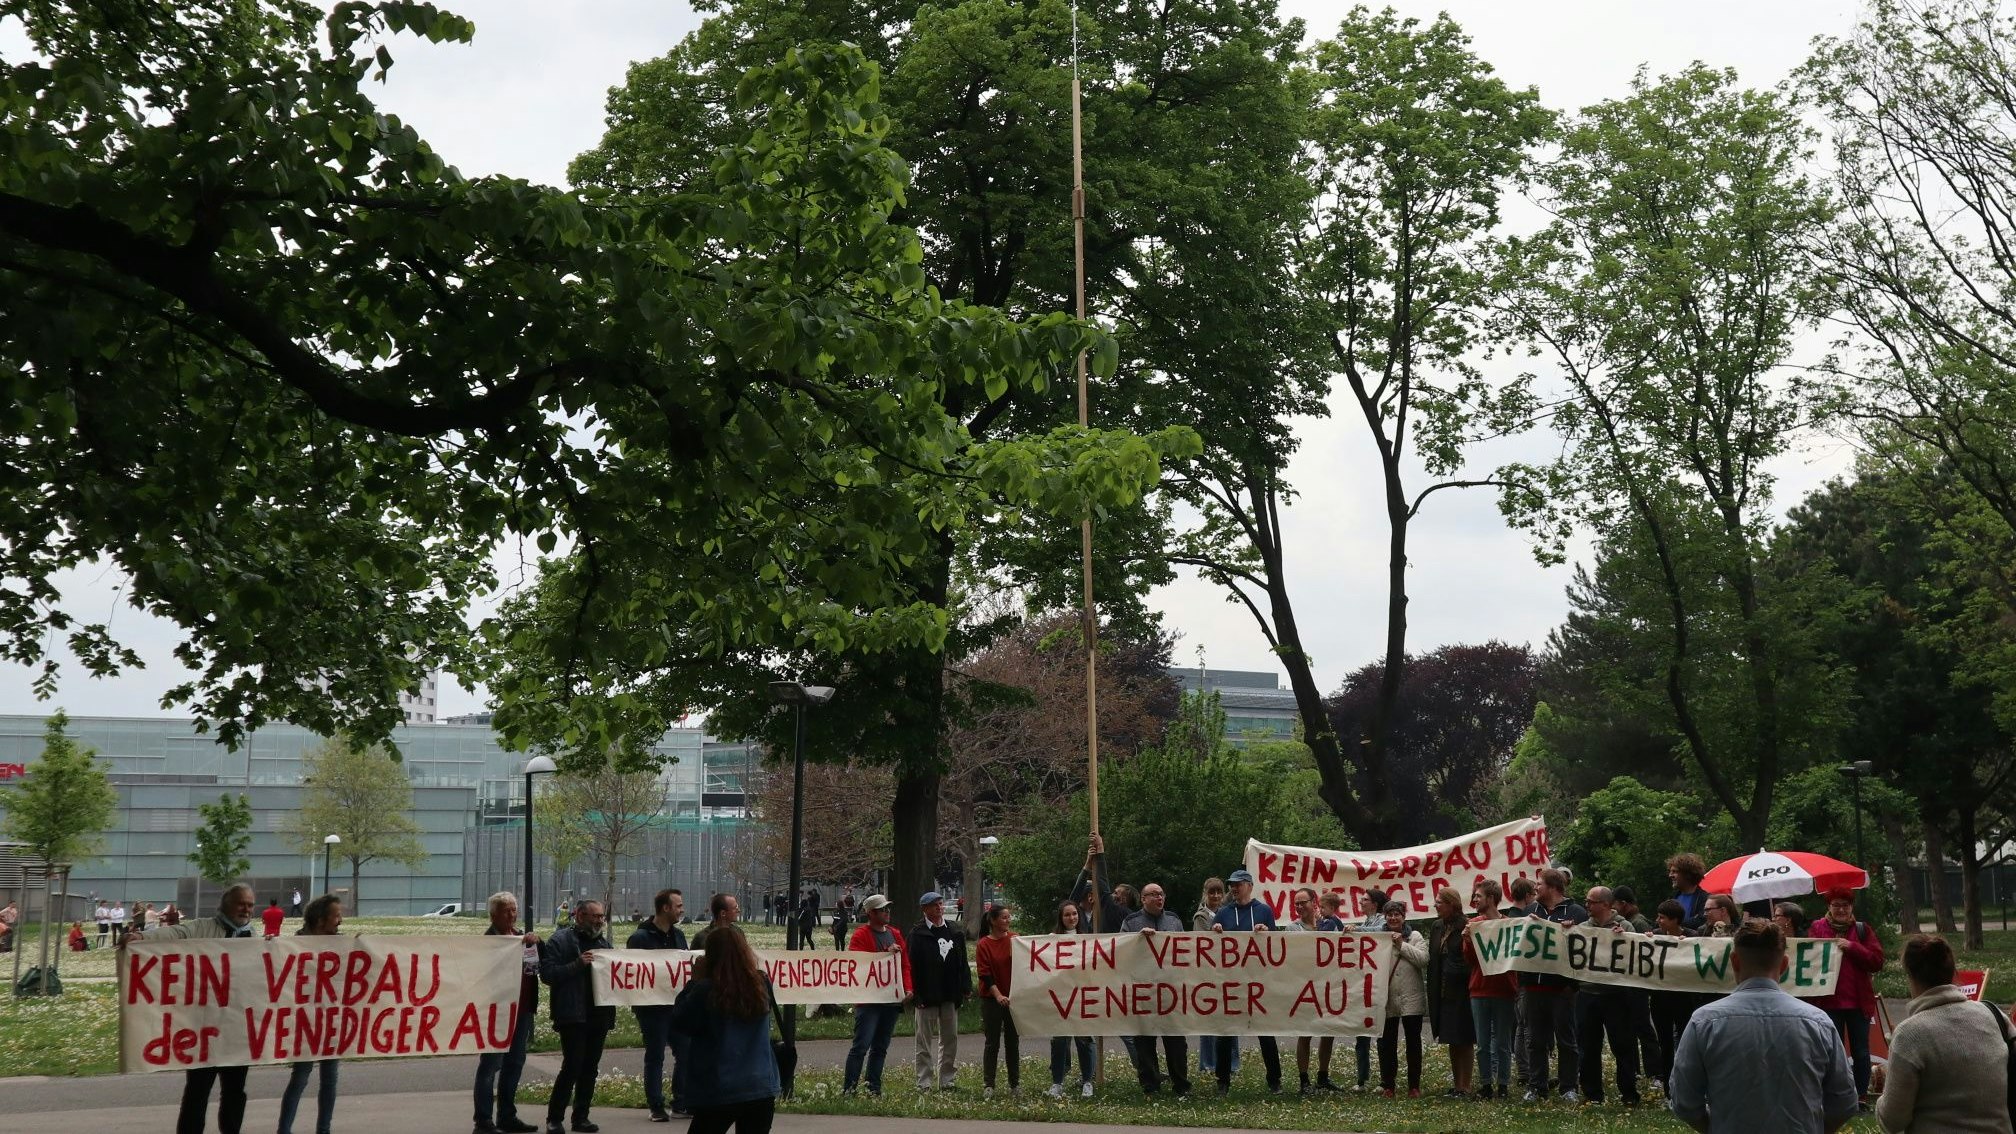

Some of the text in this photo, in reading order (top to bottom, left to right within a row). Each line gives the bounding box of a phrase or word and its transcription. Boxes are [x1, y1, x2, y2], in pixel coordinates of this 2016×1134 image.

[1257, 852, 1339, 884] KEIN
[1350, 840, 1492, 881] VERBAU
[1748, 865, 1791, 879] KPÖ
[128, 950, 440, 1008] KEIN VERBAU
[610, 960, 656, 991] KEIN
[764, 957, 858, 989] VENEDIGER
[865, 954, 899, 1000] AU!
[1029, 936, 1377, 972] KEIN VERBAU DER
[1474, 923, 1833, 988] WIESE BLEIBT WE!
[1048, 973, 1375, 1029] VENEDIGER AU!
[142, 1001, 518, 1066] der VENEDIGER AU
